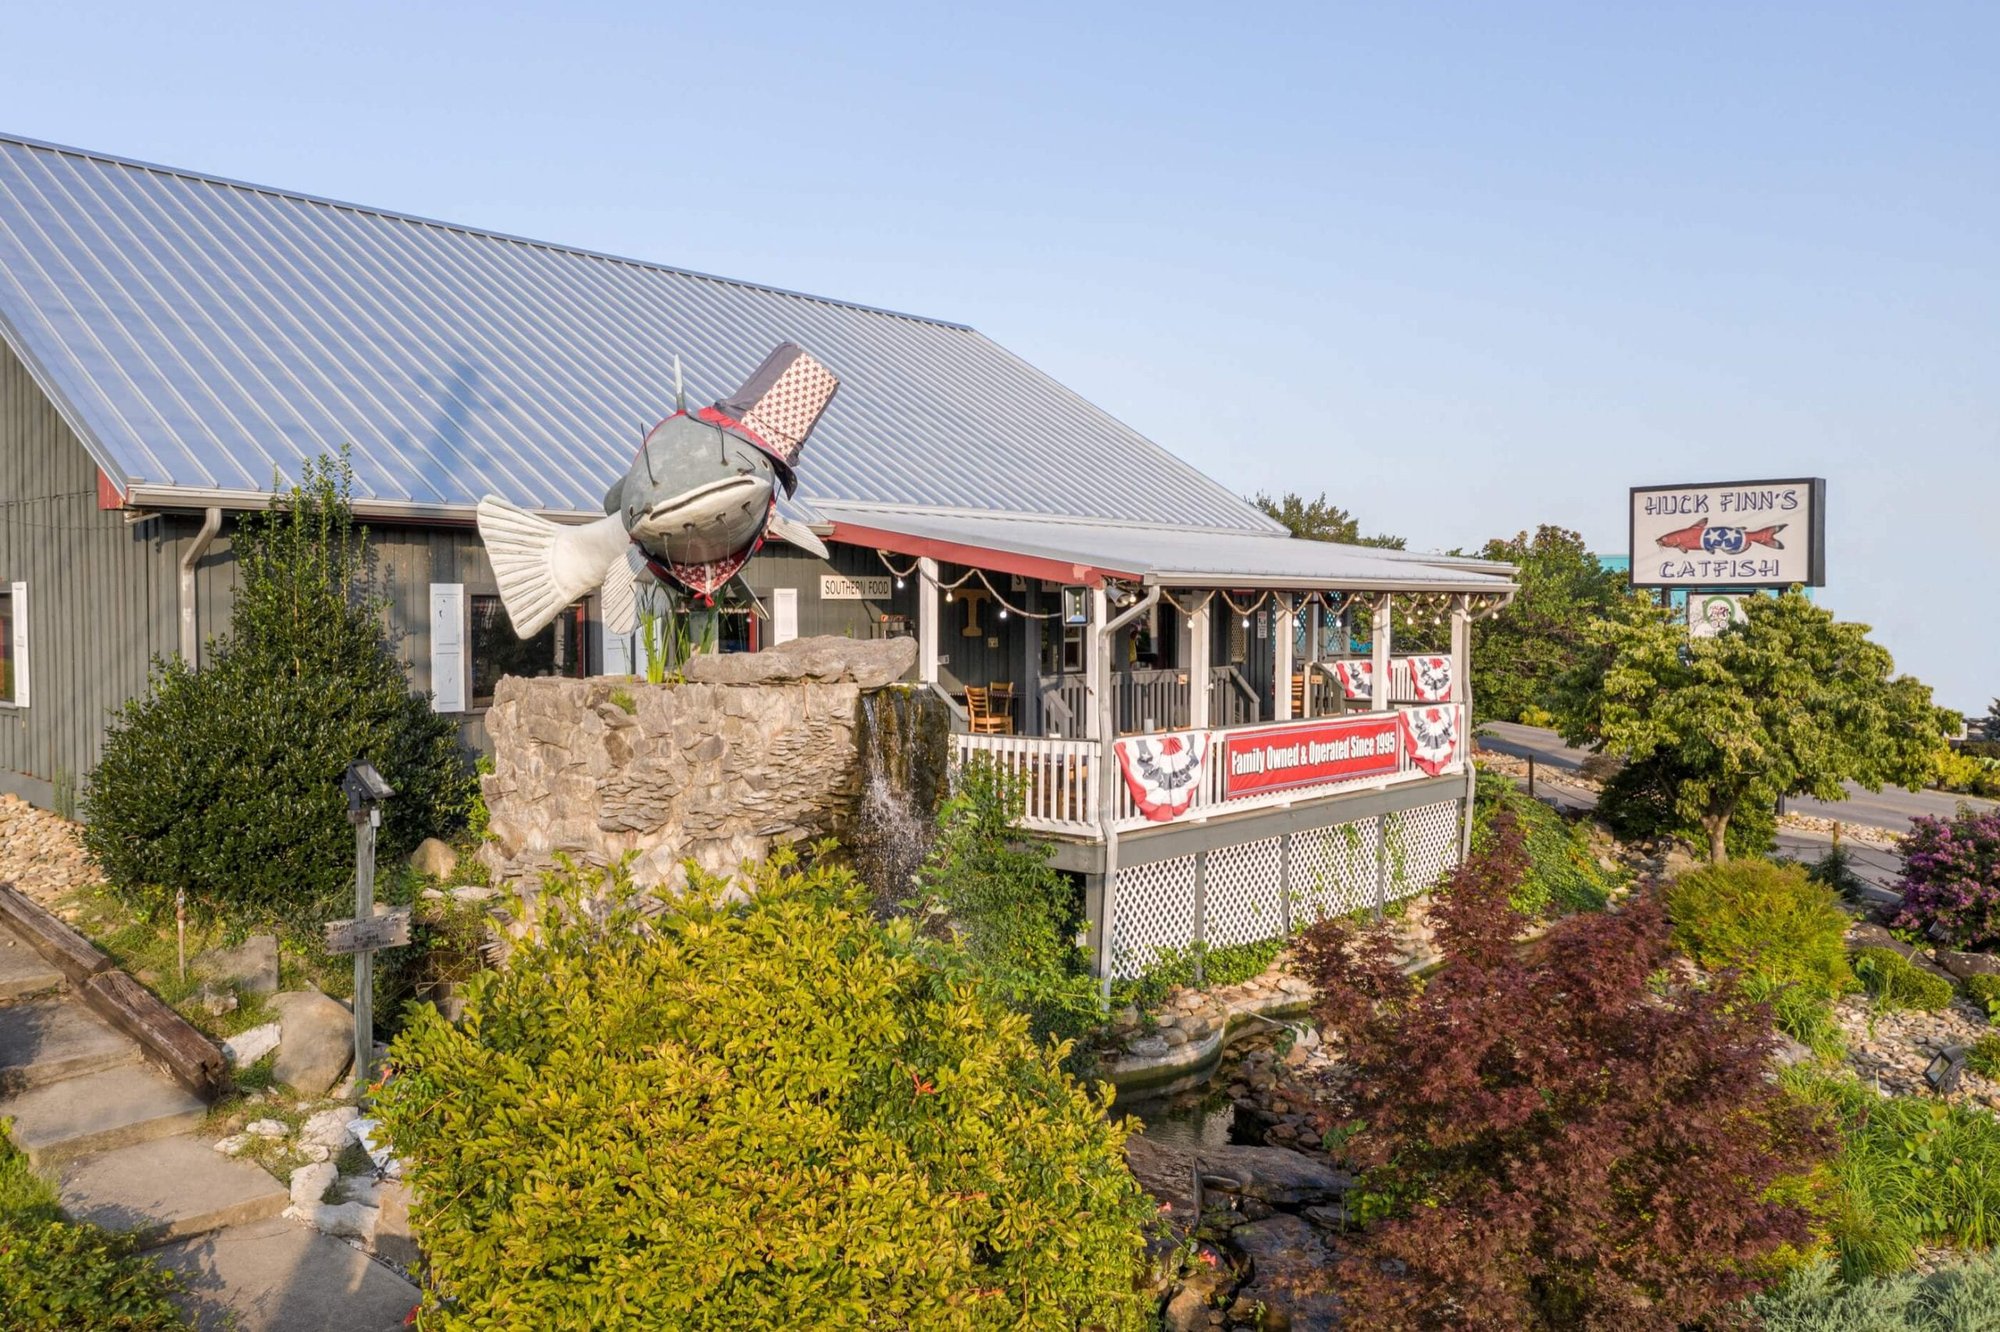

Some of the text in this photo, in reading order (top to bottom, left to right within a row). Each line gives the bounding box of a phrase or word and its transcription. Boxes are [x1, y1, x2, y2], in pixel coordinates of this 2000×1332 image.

[1645, 489, 1798, 515] HUCK FINN'S
[1660, 560, 1779, 578] CATFISH
[825, 580, 889, 595] SOUTHERN FOOD
[1231, 731, 1396, 775] Family Owned & Operated Since 1995
